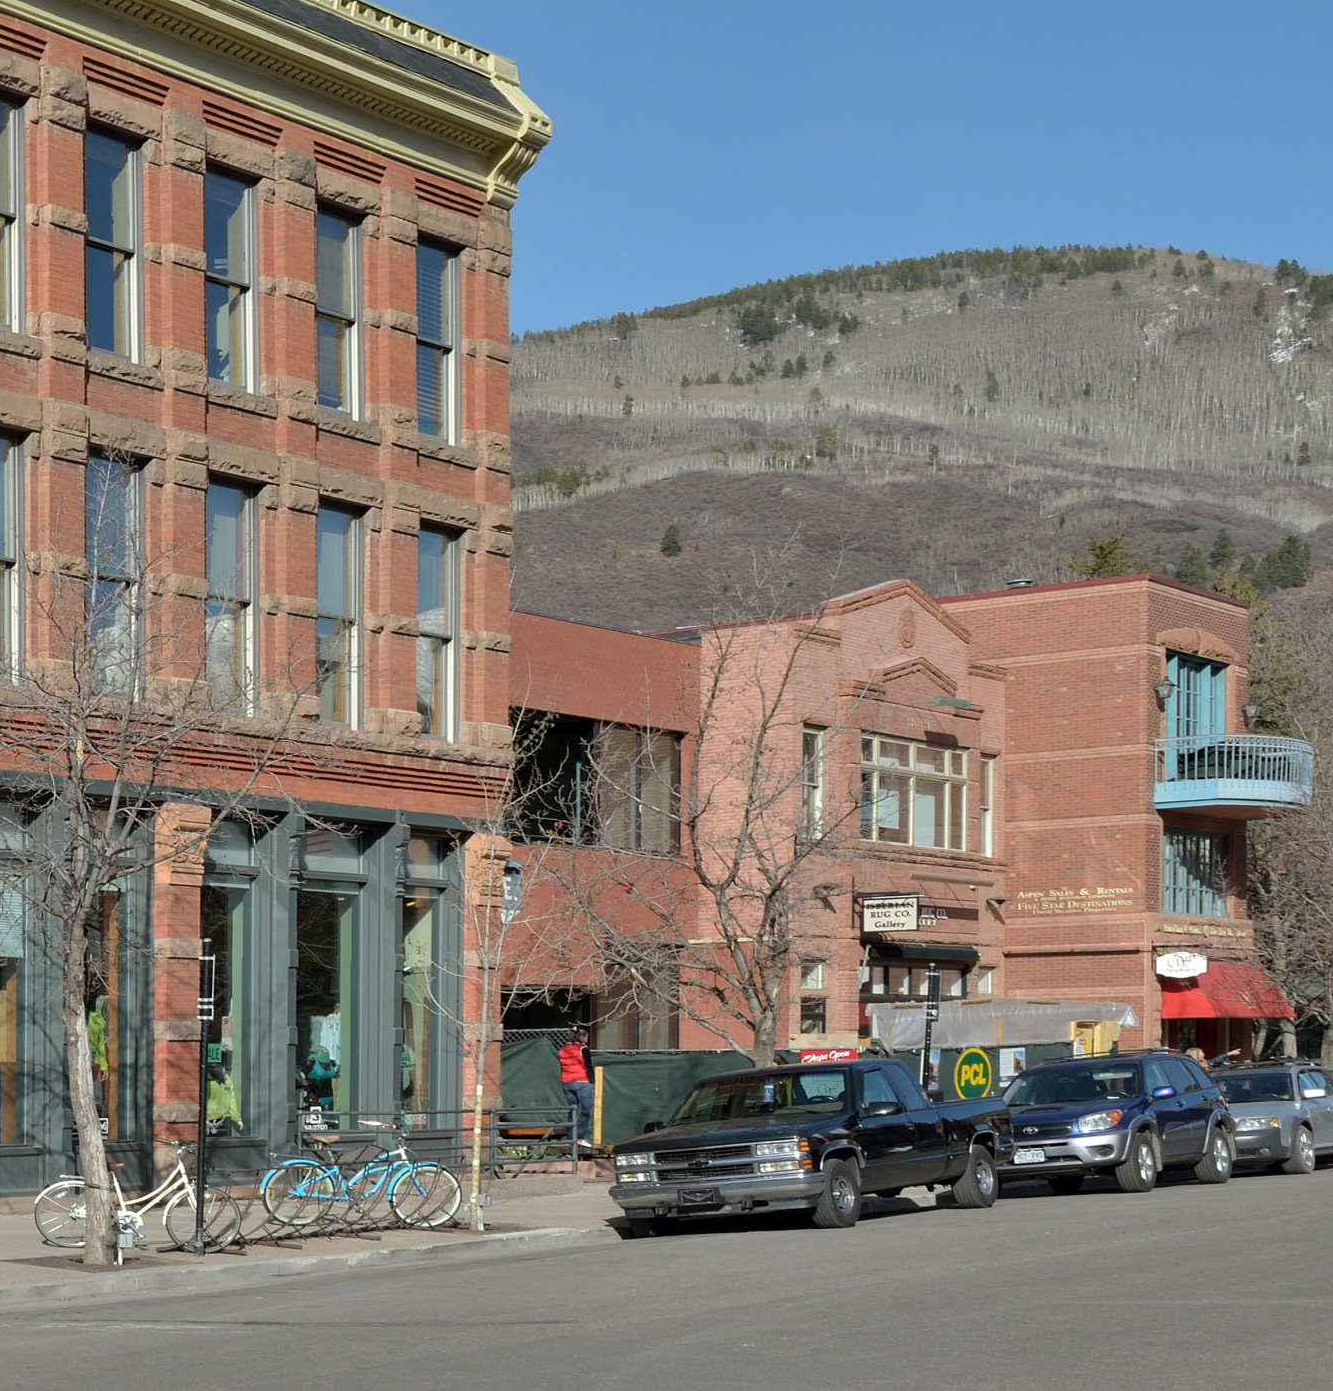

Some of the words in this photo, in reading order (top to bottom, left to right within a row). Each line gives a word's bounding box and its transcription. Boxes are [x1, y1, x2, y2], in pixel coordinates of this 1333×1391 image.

[1049, 889, 1074, 897] SALES
[1079, 888, 1090, 896] &
[1097, 887, 1133, 895] RENTALS
[1017, 902, 1038, 911] FIVE
[1042, 901, 1065, 910] STAR
[1068, 899, 1133, 909] DESTINATIONS
[870, 911, 891, 919] RUG
[895, 910, 911, 918] CO.
[874, 920, 906, 929] Gallery
[801, 1052, 828, 1064] Shops
[828, 1050, 851, 1060] Open
[960, 1063, 987, 1087] PCL
